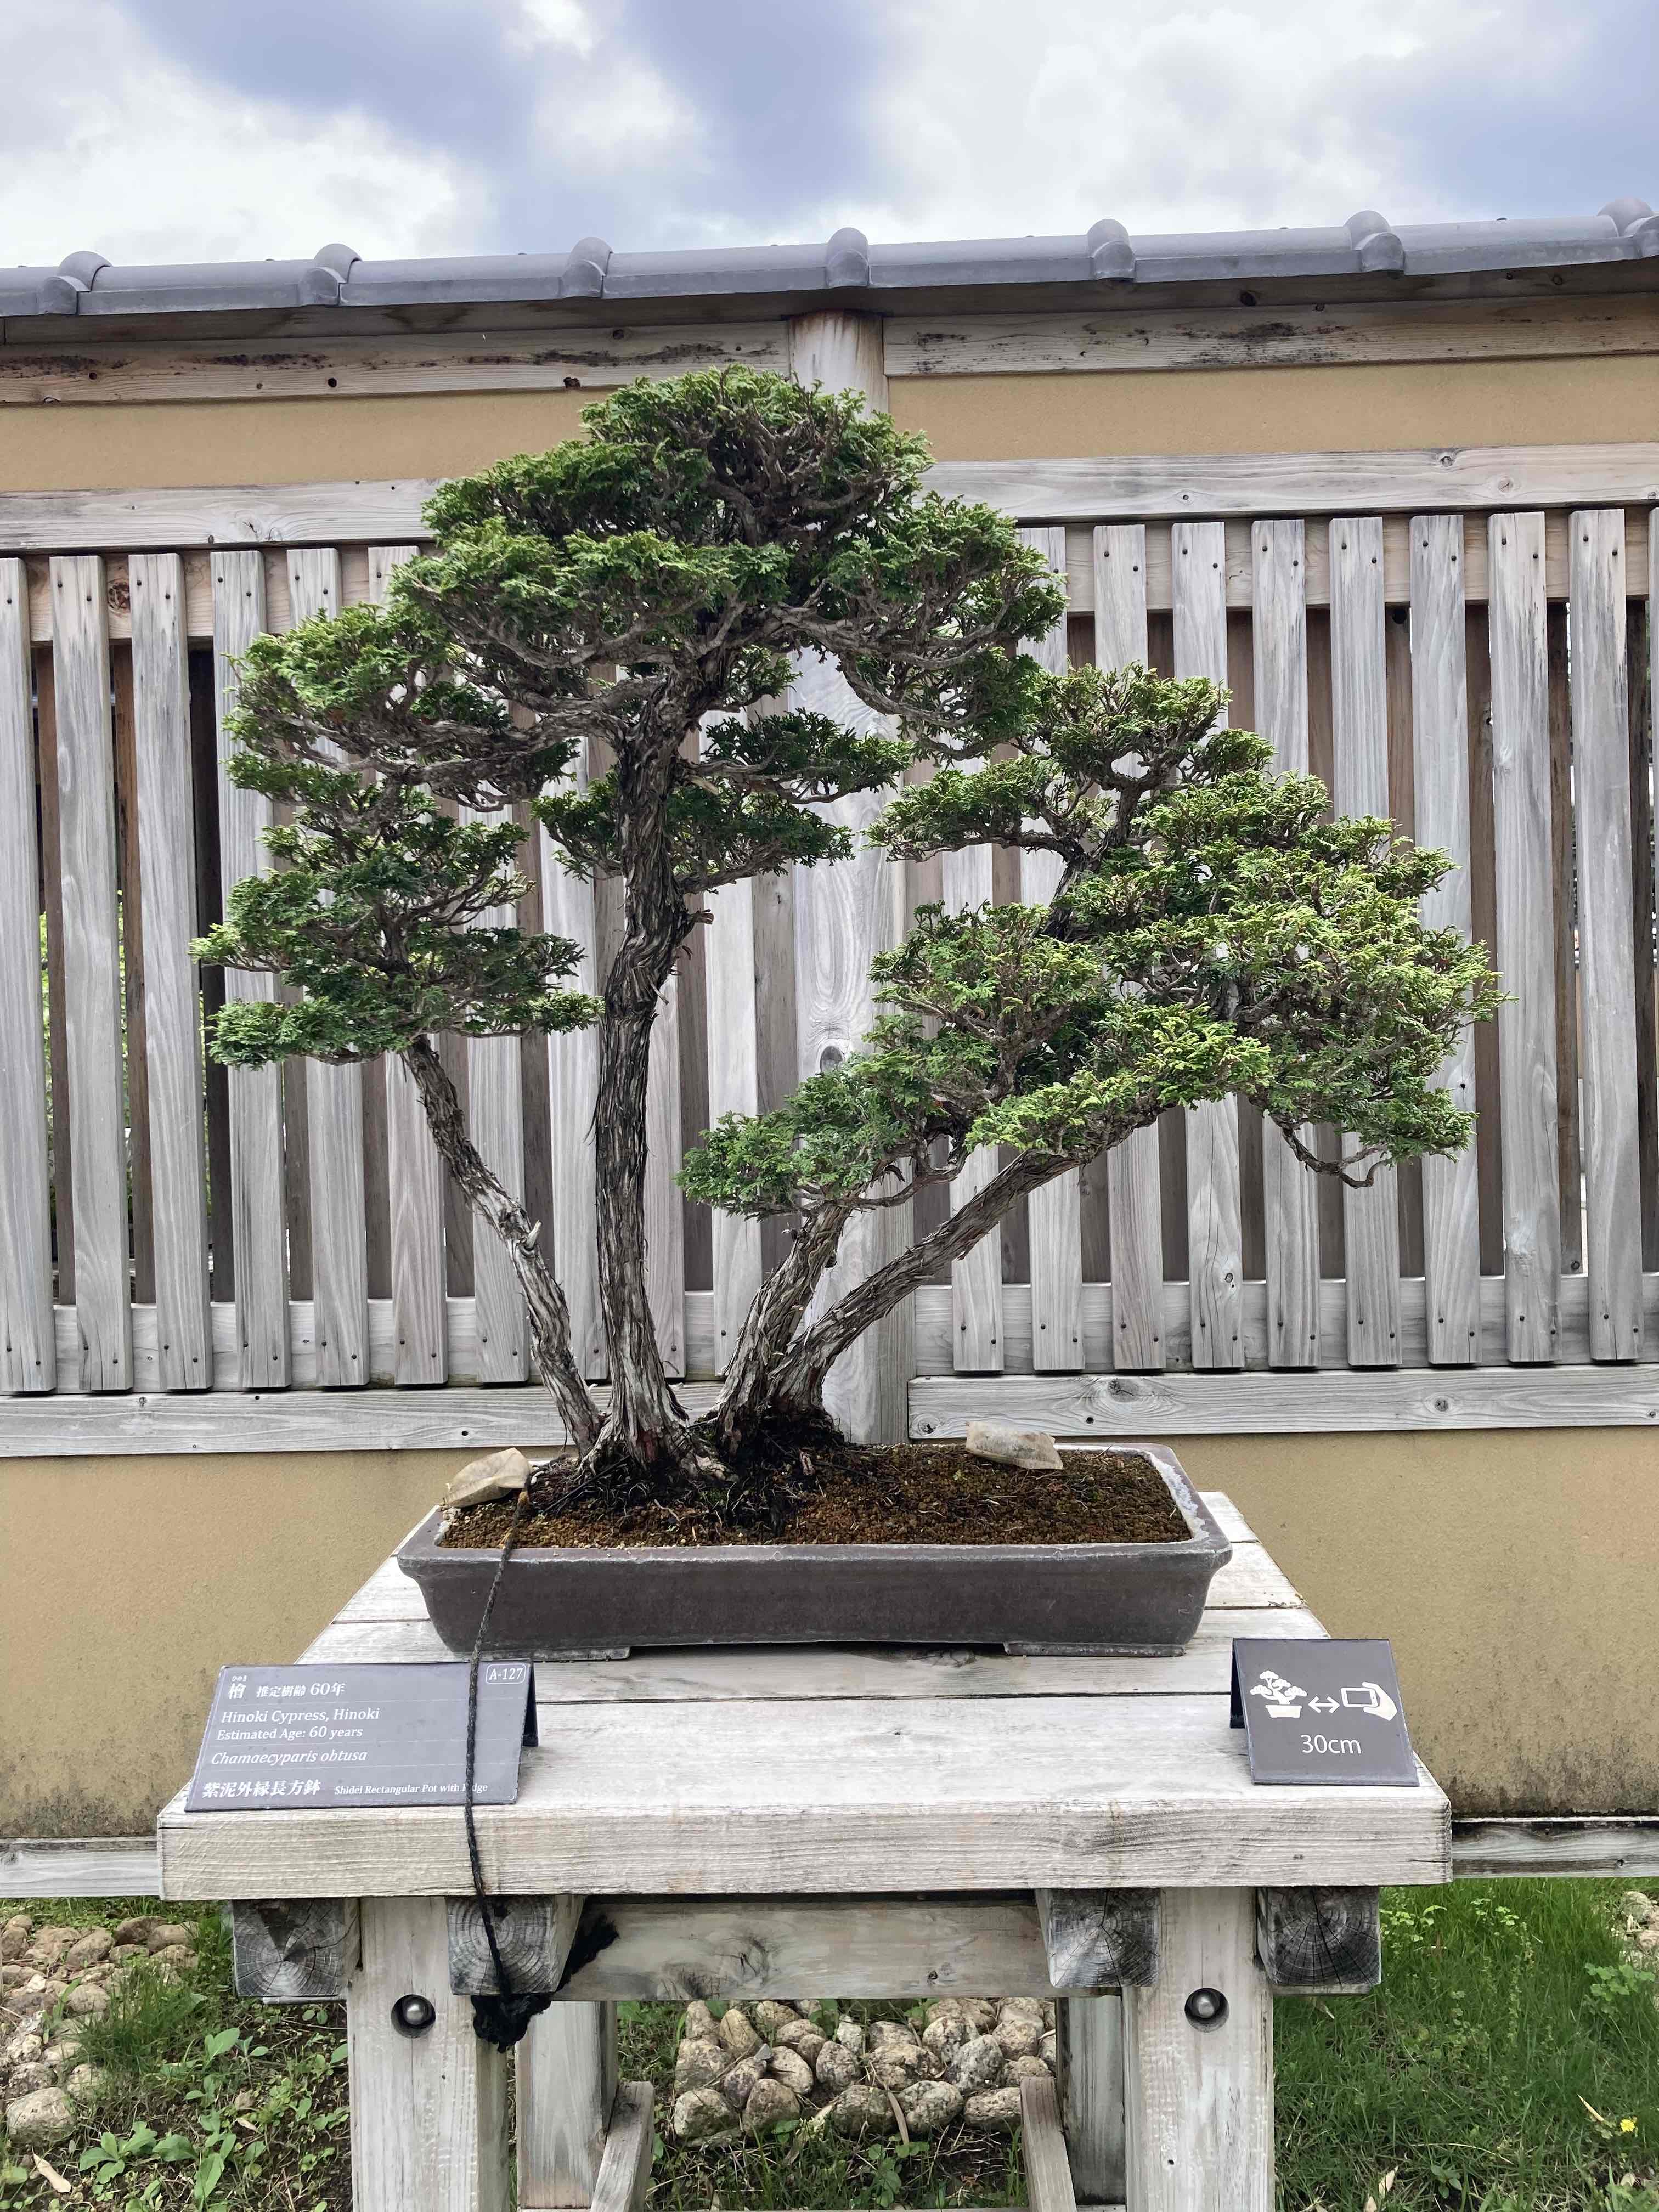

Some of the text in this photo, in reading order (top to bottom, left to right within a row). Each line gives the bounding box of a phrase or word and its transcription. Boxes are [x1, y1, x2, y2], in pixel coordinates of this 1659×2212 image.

[489, 1668, 523, 1680] A-127
[229, 1683, 246, 1699] 檜
[222, 1708, 380, 1724] Hinoki Cypress, Hinoki
[217, 1726, 363, 1741] Estimated Age: 60 years
[1301, 1734, 1362, 1754] 30cm
[211, 1750, 368, 1765] Chamaecyparis obtusa
[202, 1780, 320, 1798] 紫泥外縁長方鉢
[365, 1785, 420, 1795] Rectangular
[422, 1784, 438, 1792] Pot
[440, 1784, 460, 1792] with
